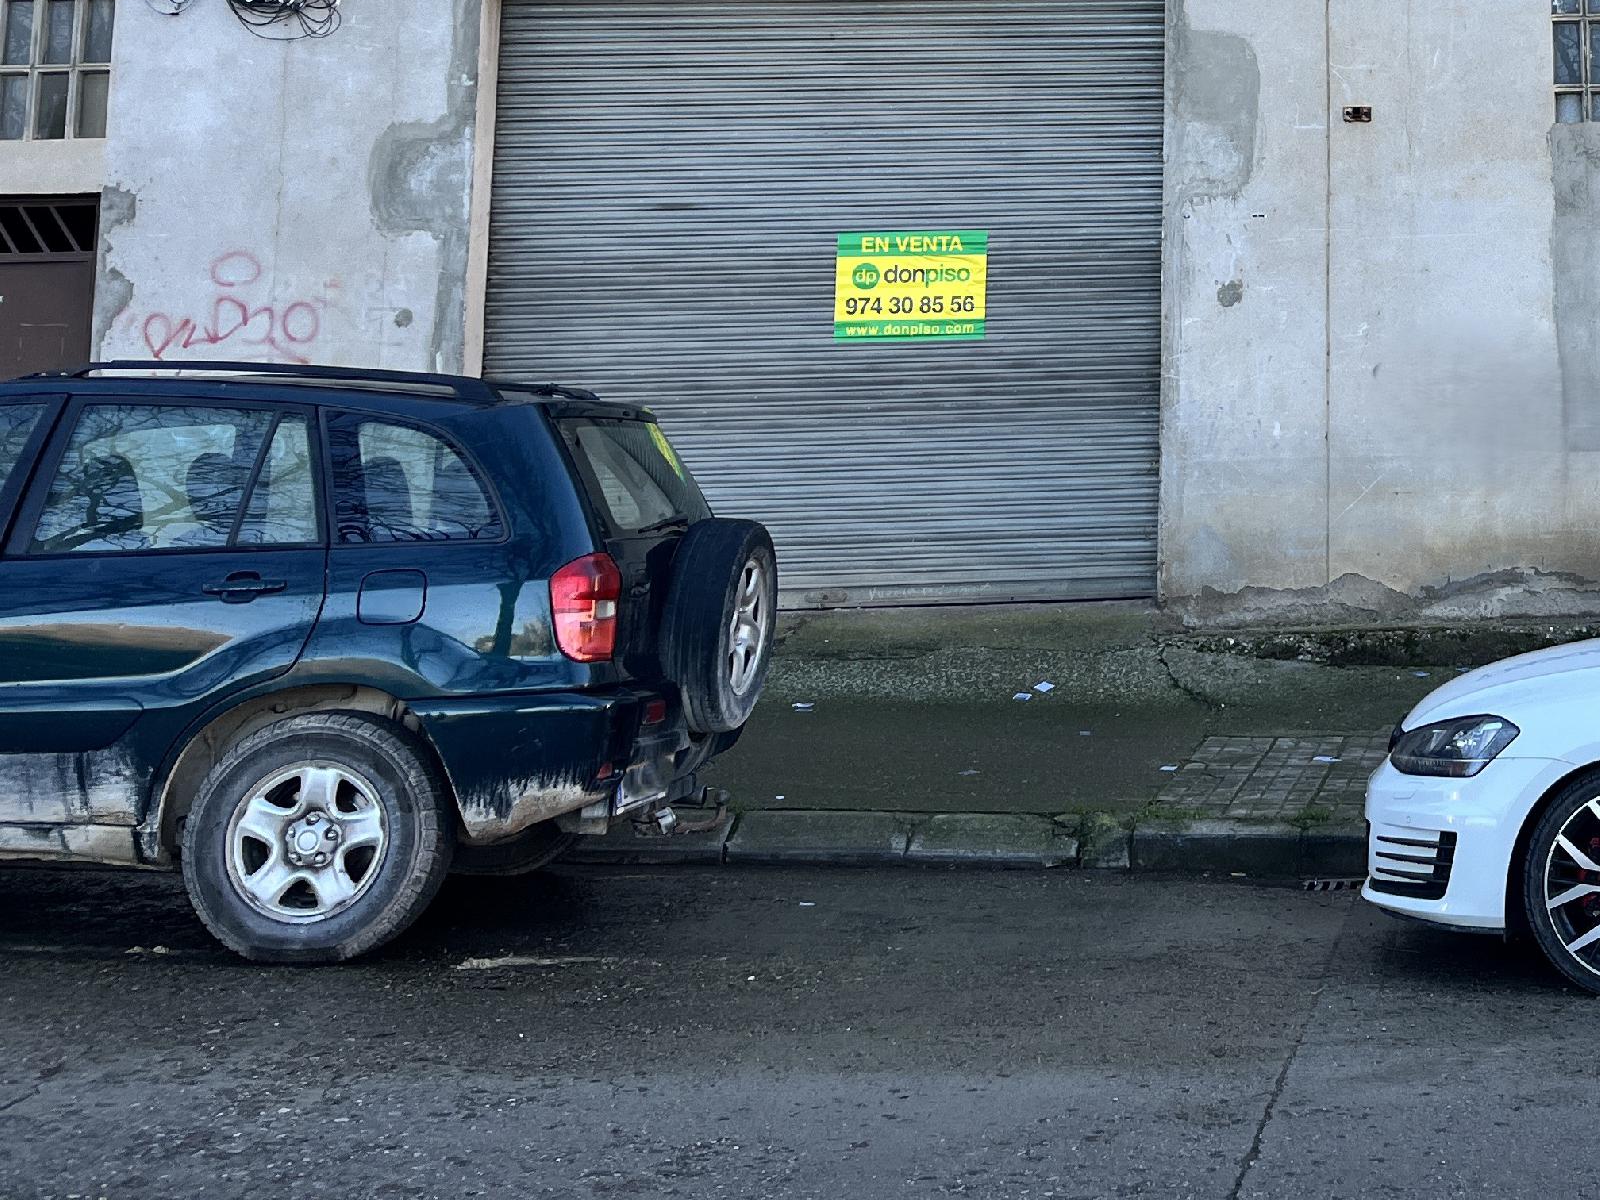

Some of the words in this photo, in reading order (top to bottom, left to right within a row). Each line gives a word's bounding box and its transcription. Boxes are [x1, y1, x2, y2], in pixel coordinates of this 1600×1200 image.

[861, 236, 889, 253] EN
[896, 235, 963, 252] VENTA
[855, 268, 877, 286] dp
[883, 264, 971, 288] donpiso
[845, 297, 883, 316] 974
[888, 296, 914, 314] 30
[919, 295, 944, 314] 85
[950, 295, 975, 313] 56
[845, 322, 975, 337] www.donpiso.com
